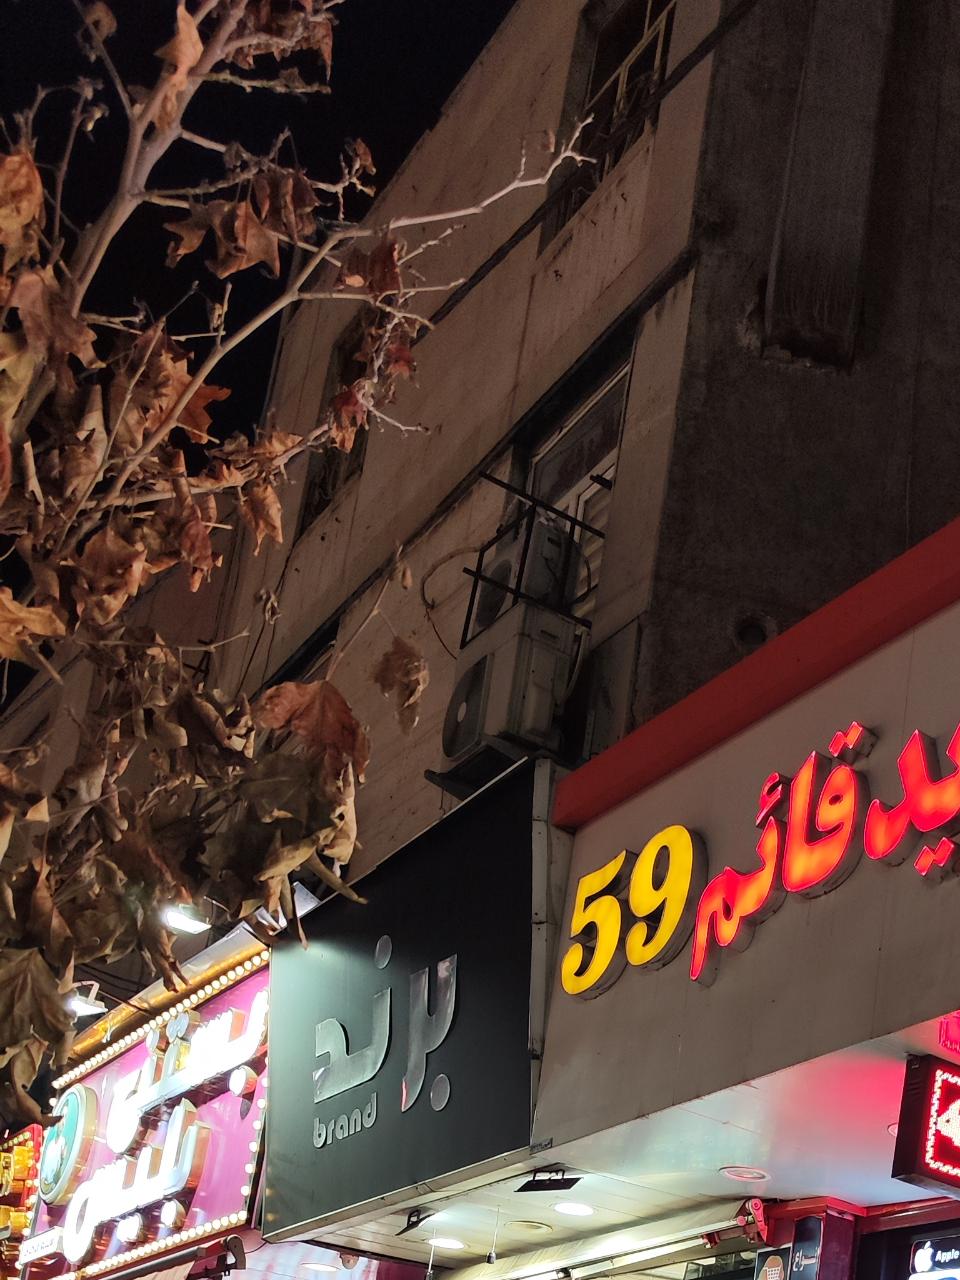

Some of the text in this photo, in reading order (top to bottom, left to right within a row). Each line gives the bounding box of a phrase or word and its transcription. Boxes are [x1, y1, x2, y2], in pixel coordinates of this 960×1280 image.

[561, 823, 697, 997] 59
[689, 721, 868, 983] قائم
[313, 935, 457, 1112] برند
[312, 1093, 378, 1149] brand
[935, 1249, 960, 1263] Apple
